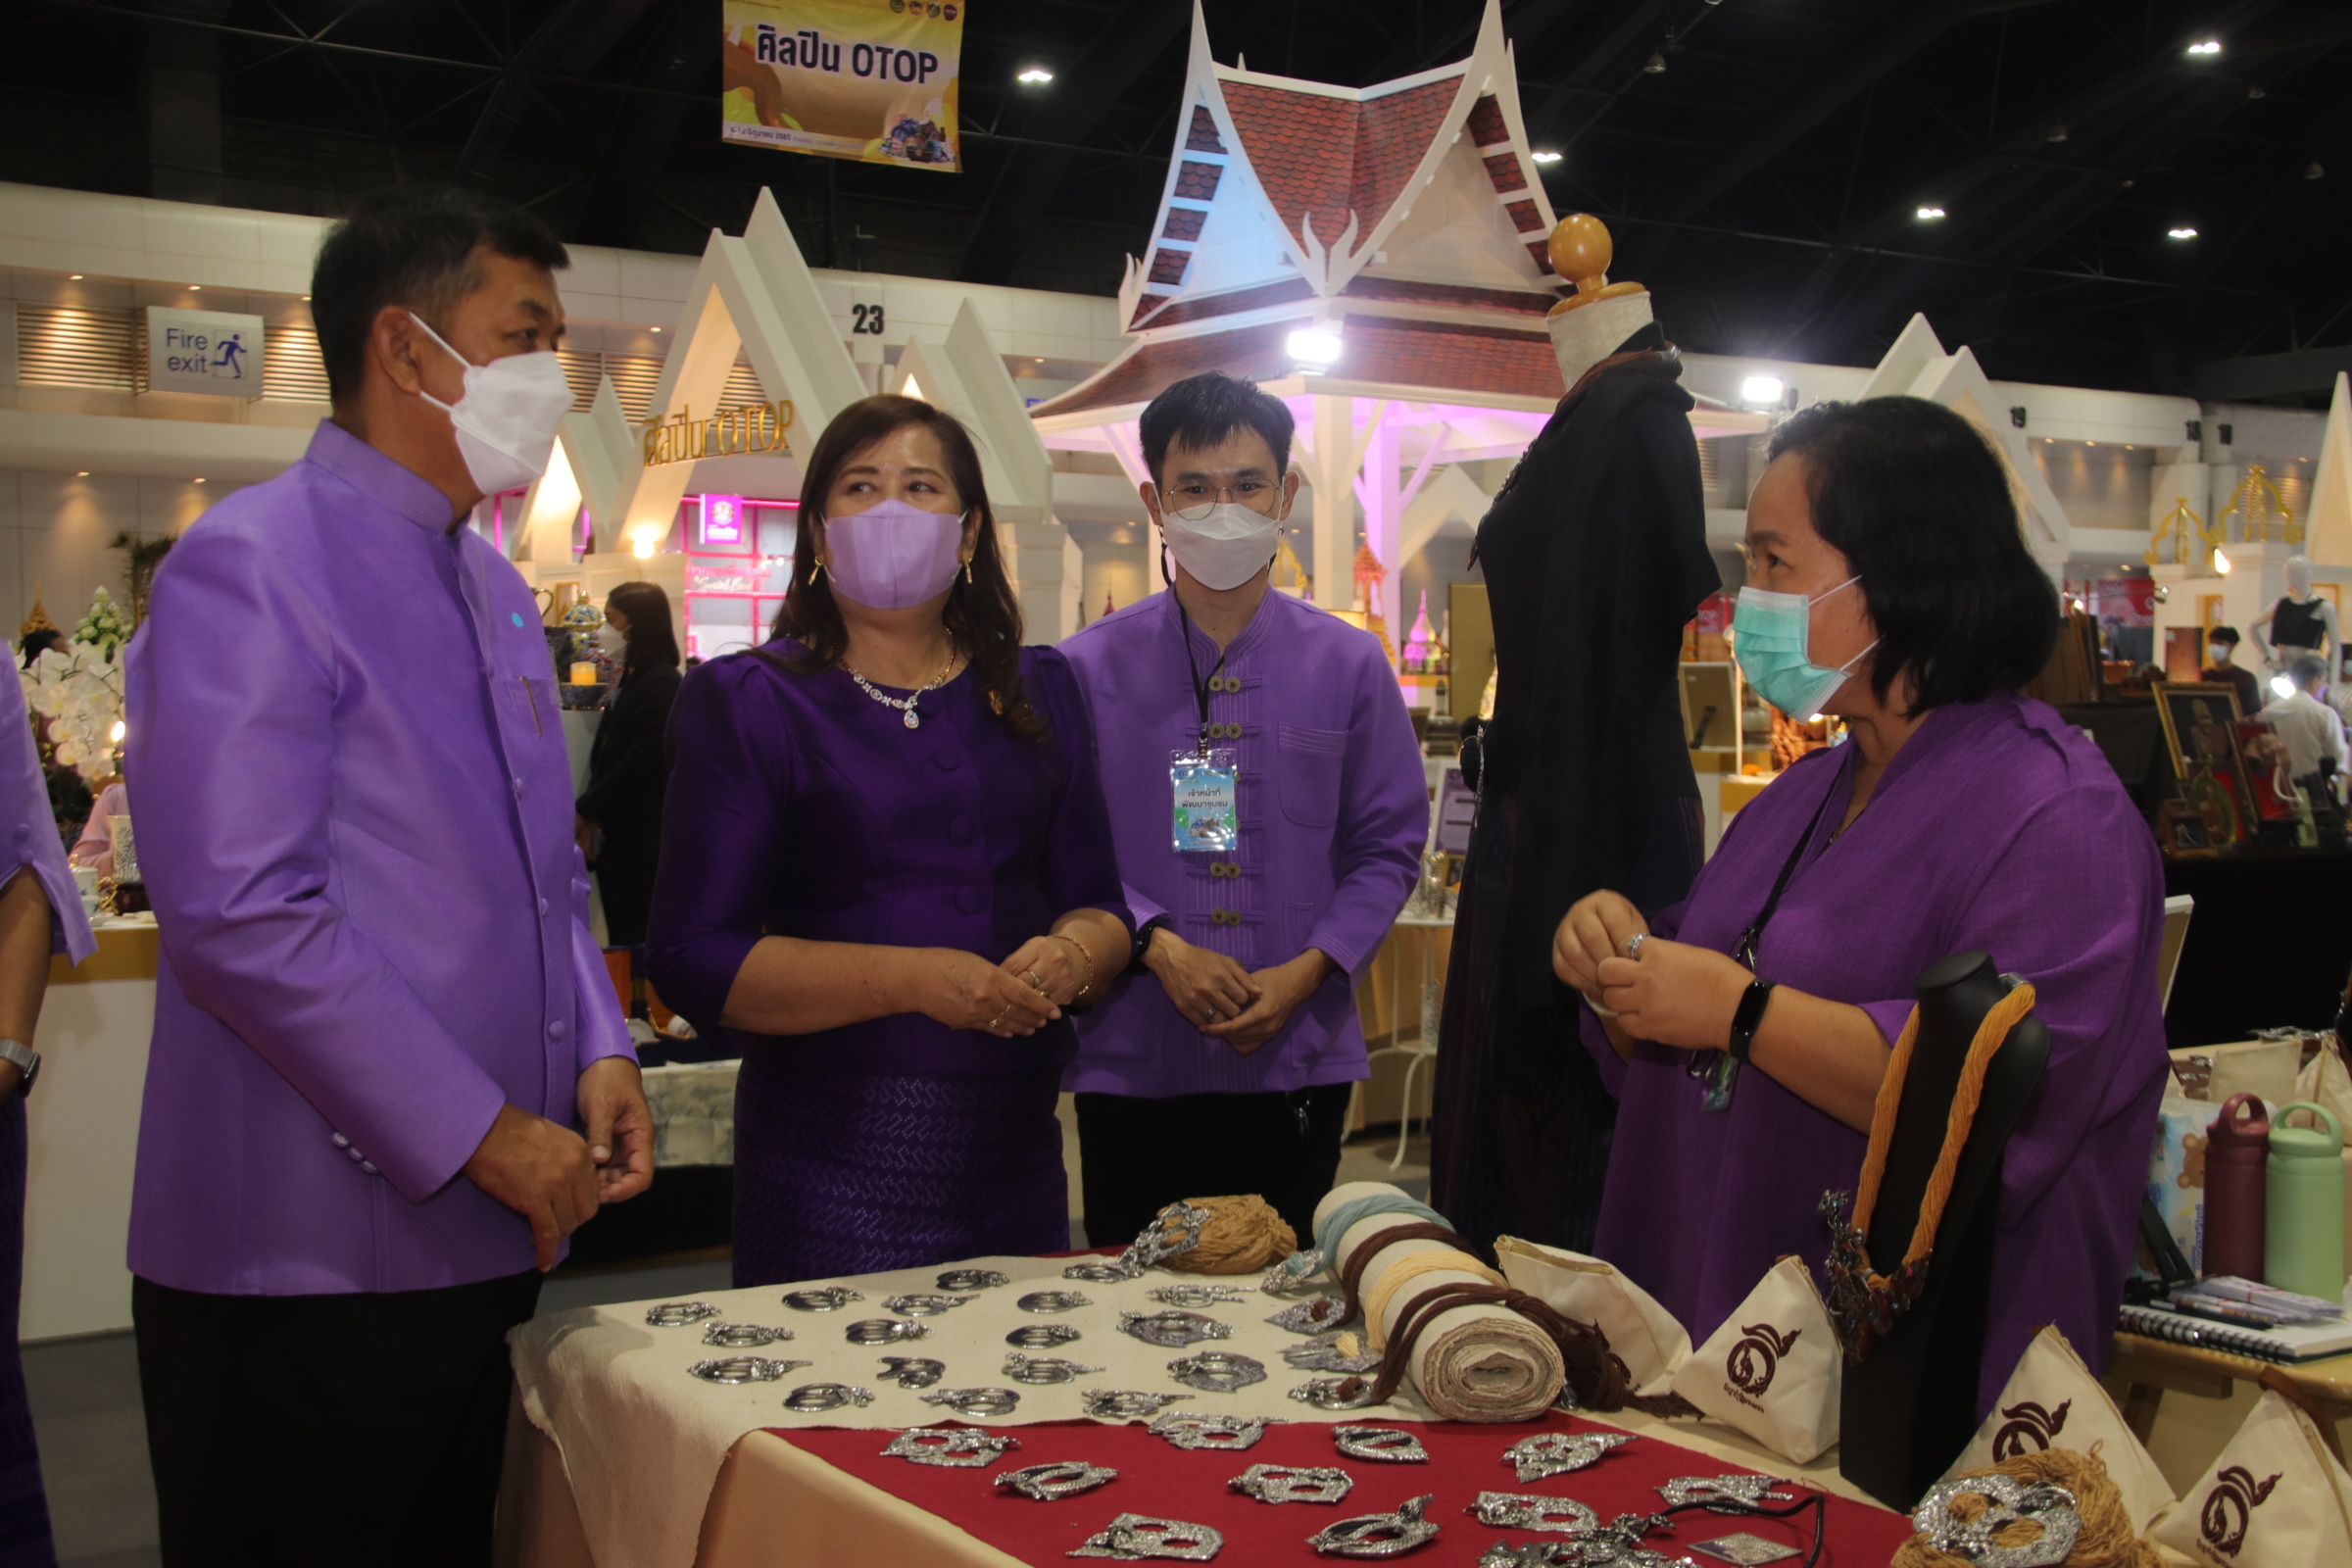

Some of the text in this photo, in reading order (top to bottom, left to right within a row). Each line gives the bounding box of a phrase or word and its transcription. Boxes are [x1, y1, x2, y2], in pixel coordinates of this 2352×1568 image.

[758, 24, 938, 84] ศิลปิน OTOP
[853, 303, 884, 335] 23
[167, 327, 208, 350] Fire
[168, 354, 208, 373] exit
[717, 400, 795, 457] OTOP
